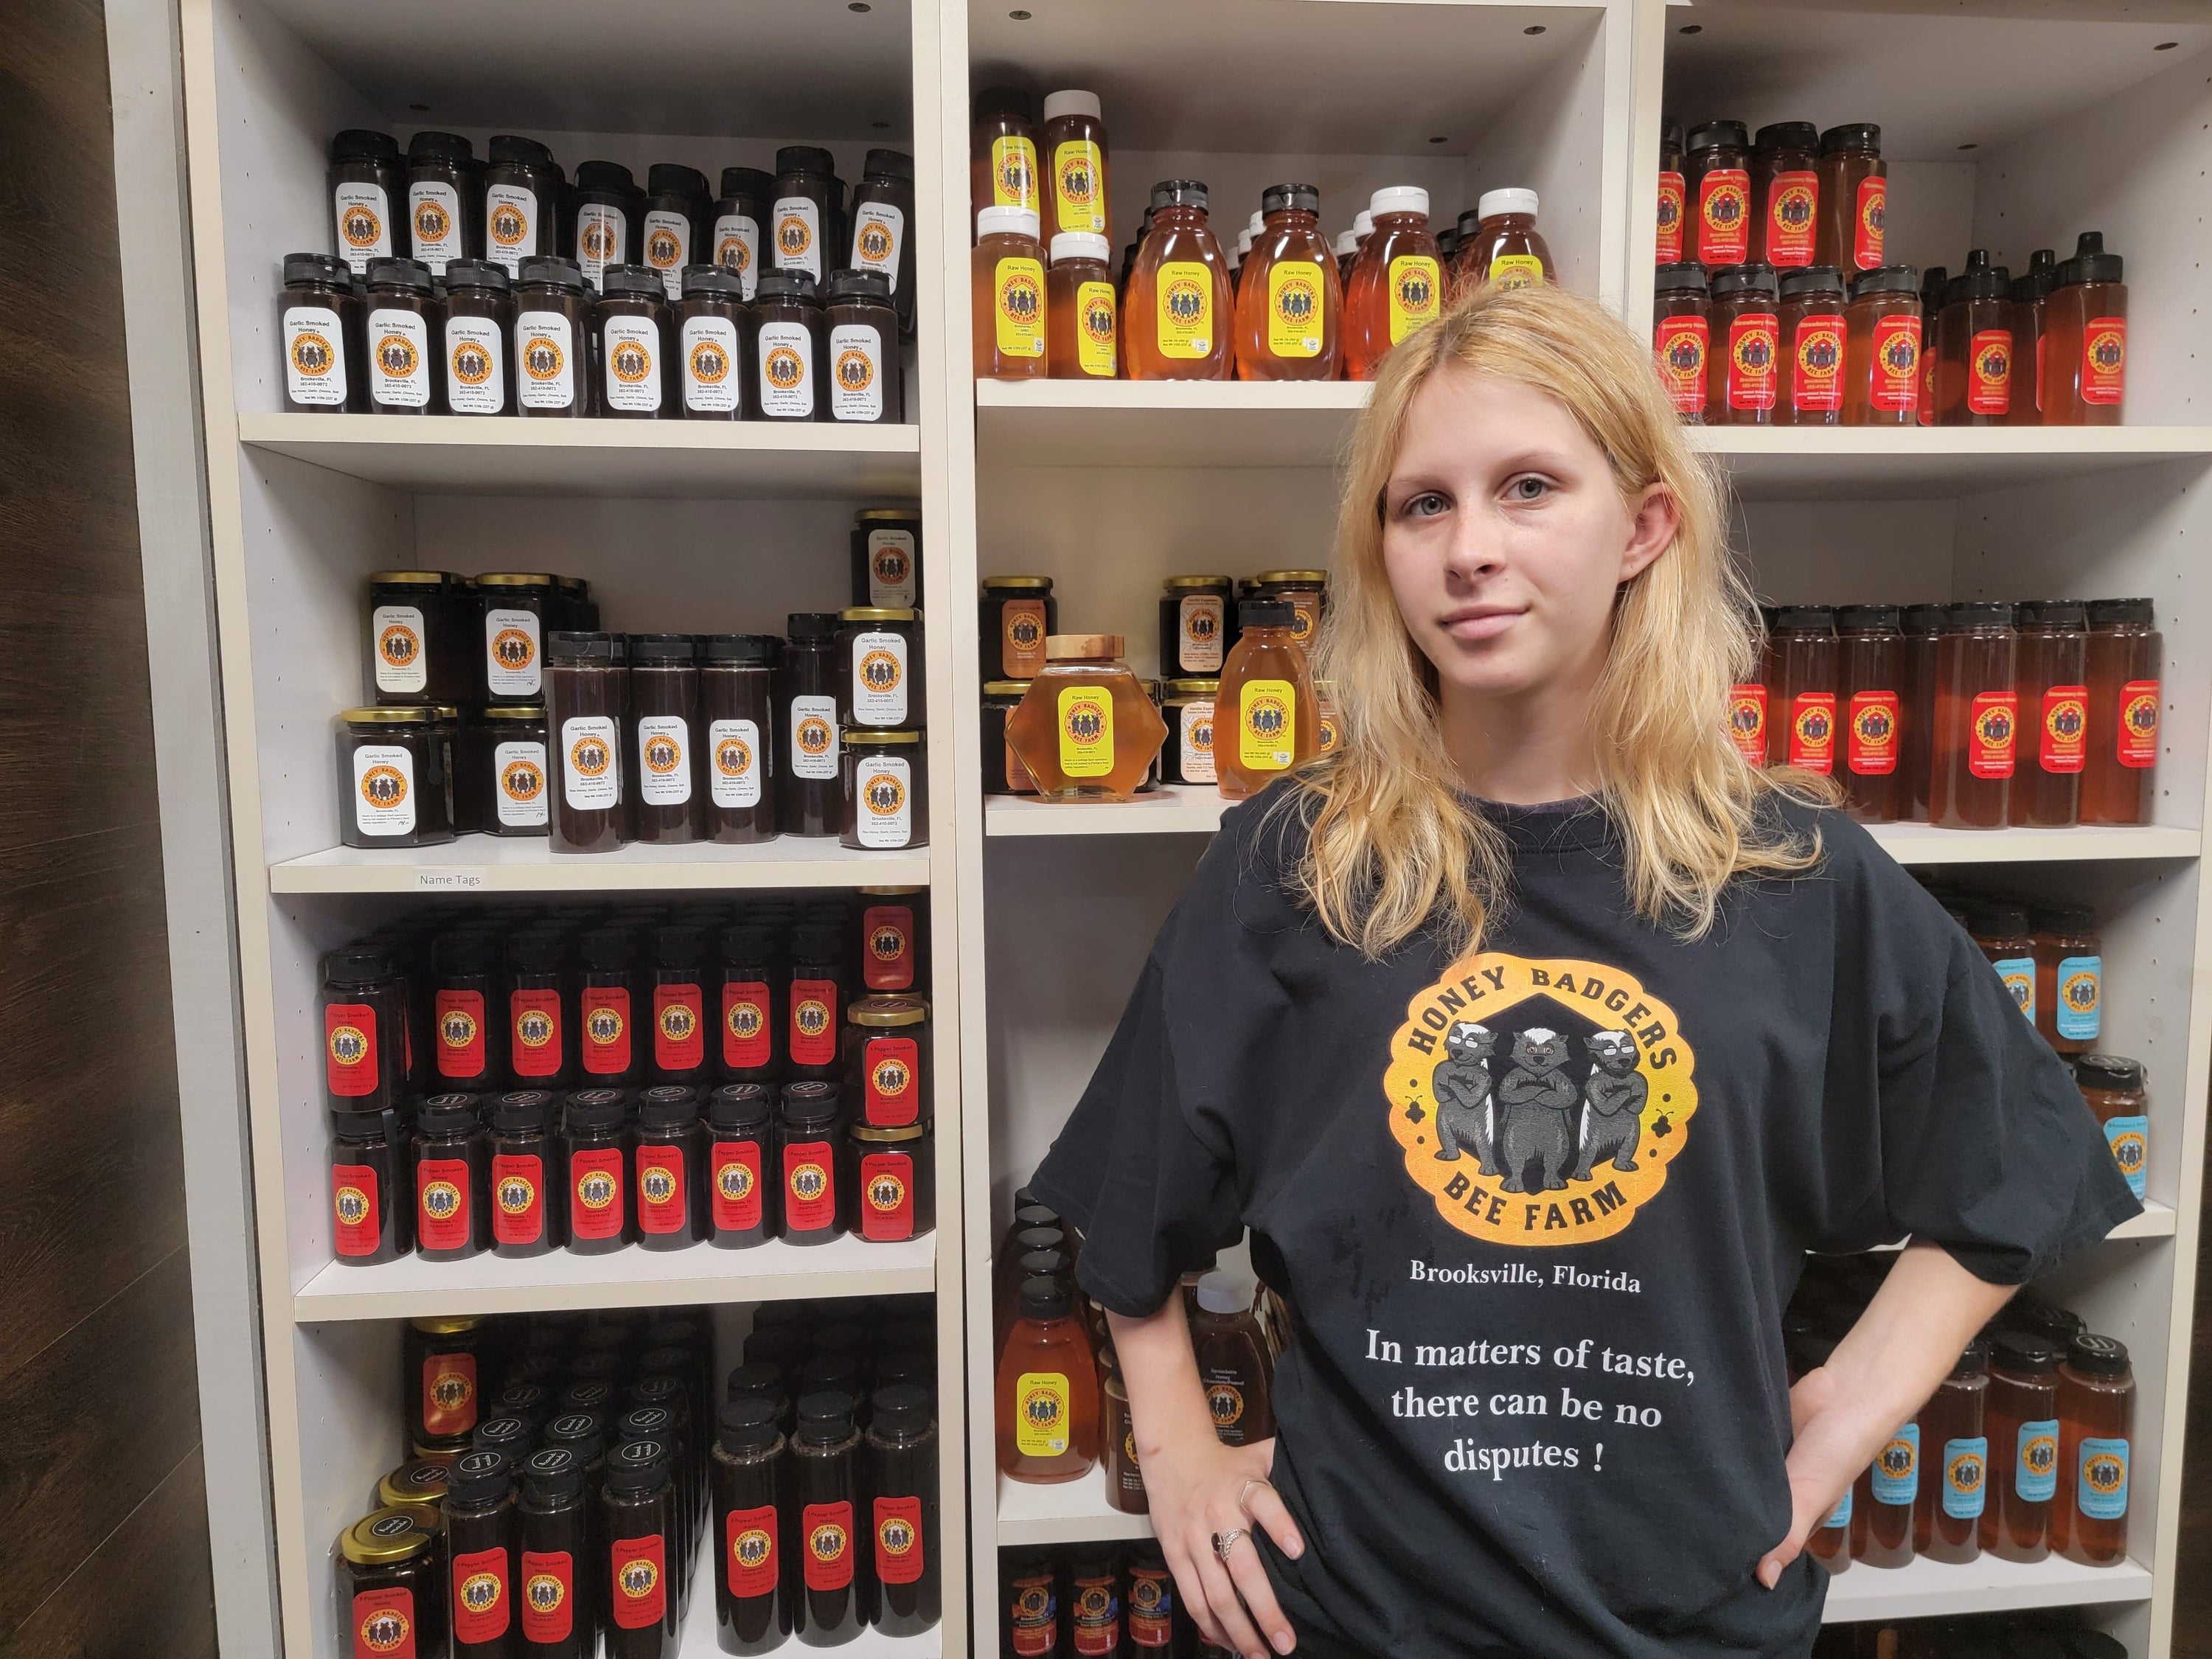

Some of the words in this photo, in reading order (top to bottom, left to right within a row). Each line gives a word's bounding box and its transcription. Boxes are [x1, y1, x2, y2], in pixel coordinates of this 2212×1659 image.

[420, 875, 453, 884] Name
[456, 875, 480, 886] Tags
[1408, 967, 1505, 1055] HONEY
[1531, 968, 1677, 1070] BADGERS
[1443, 1171, 1507, 1226] BEE
[1524, 1180, 1627, 1231] FARM
[1410, 1259, 1544, 1287] Brooksville,
[1553, 1265, 1641, 1293] Florida
[1365, 1329, 1402, 1363] In
[1415, 1339, 1541, 1366] matters
[1553, 1339, 1594, 1368] of
[1601, 1347, 1694, 1386] taste,
[1391, 1387, 1479, 1418] there
[1489, 1394, 1548, 1415] can
[1560, 1388, 1603, 1420] be
[1614, 1402, 1663, 1427] no
[1444, 1439, 1579, 1481] disputes
